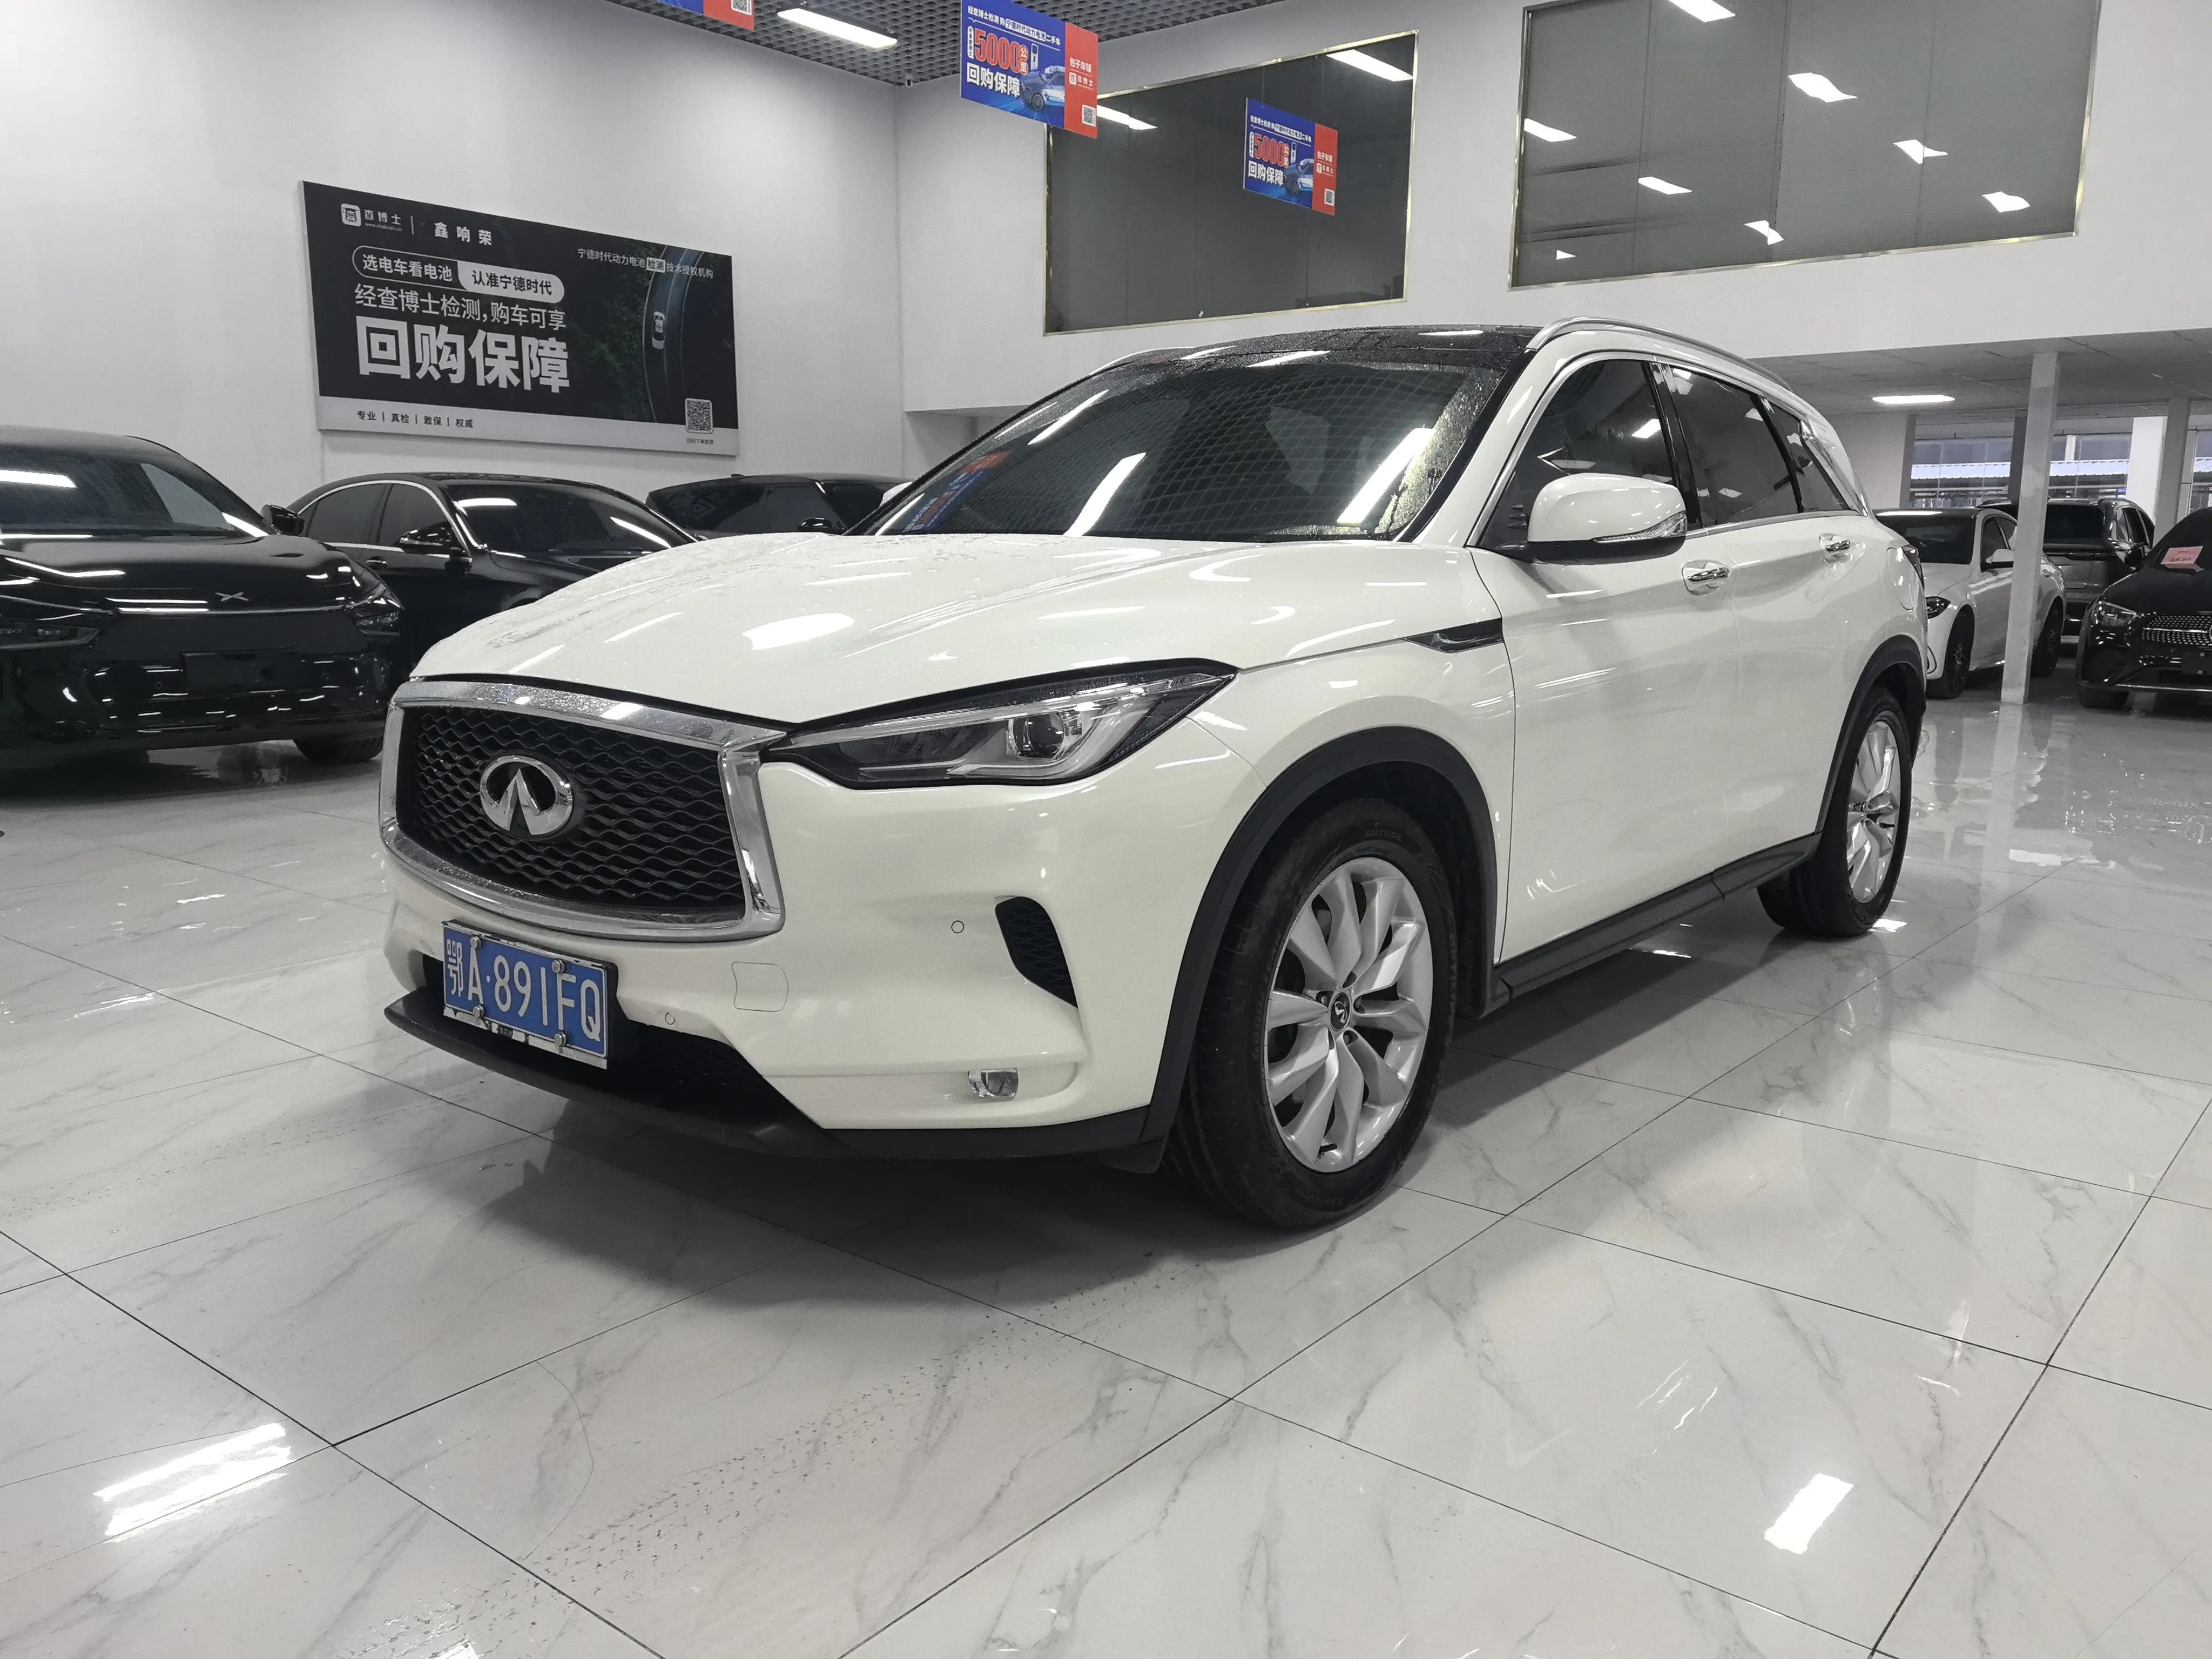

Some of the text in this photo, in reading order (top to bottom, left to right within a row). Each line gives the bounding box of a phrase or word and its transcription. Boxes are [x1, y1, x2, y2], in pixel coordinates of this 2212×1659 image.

[974, 28, 1021, 74] 5000
[967, 62, 1020, 97] 回购保障
[1248, 160, 1284, 186] 回购保障
[362, 254, 552, 296] 选电车看电池 认准宁德时代
[356, 315, 570, 394] 回购保障
[356, 410, 376, 421] 专业
[423, 415, 442, 426] 敢保
[455, 418, 474, 428] 权威
